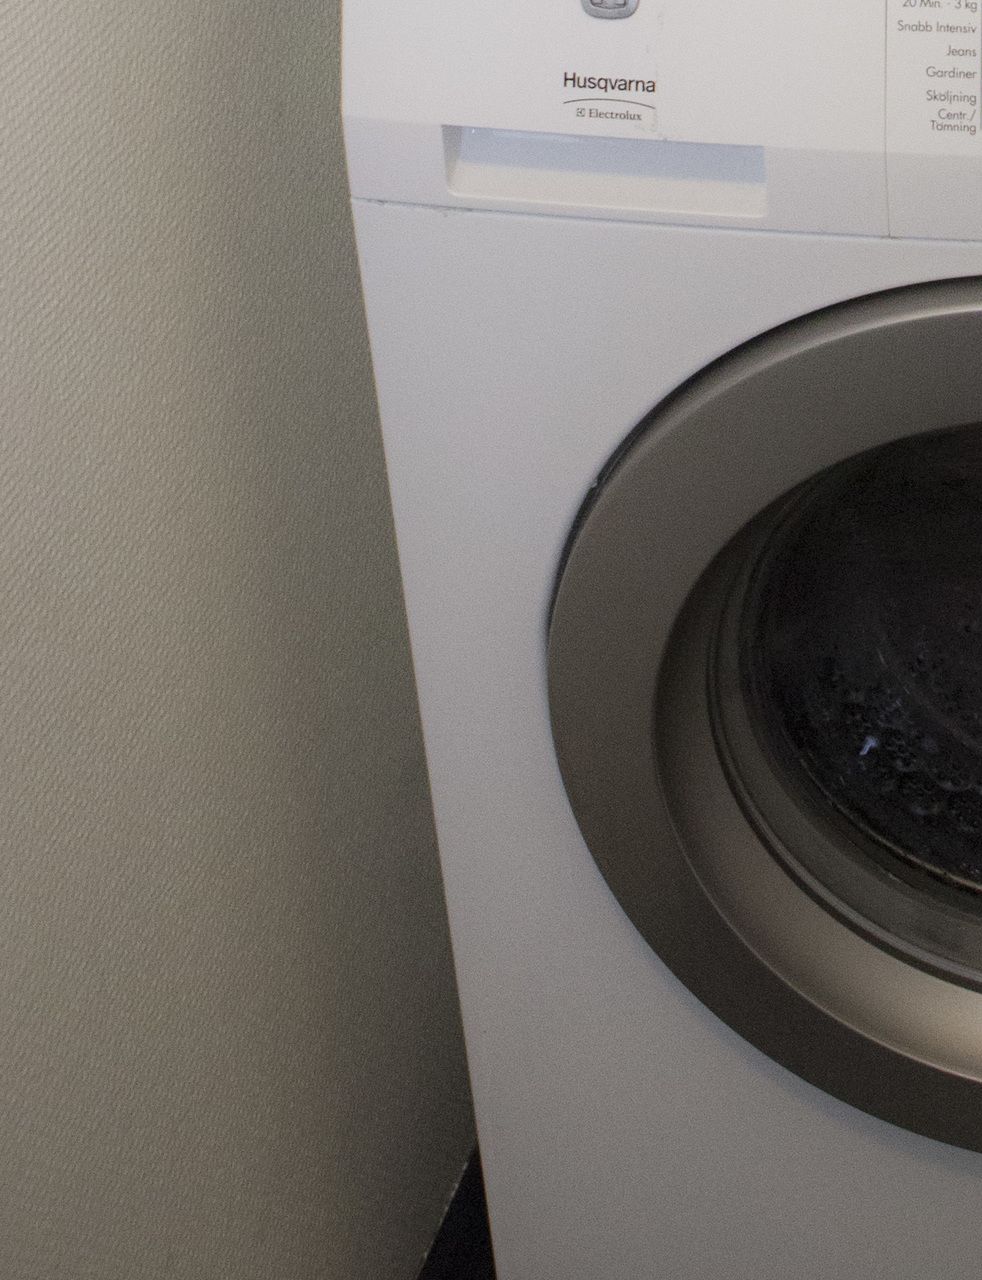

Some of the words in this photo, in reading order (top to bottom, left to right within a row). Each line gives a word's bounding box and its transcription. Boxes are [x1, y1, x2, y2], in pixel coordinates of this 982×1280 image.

[898, 20, 932, 32] Snabb
[937, 21, 977, 34] Intensiv
[946, 46, 977, 57] Jeans
[926, 67, 977, 79] Gardiner
[563, 72, 656, 93] Husqvarna
[926, 90, 977, 106] Sköljning
[589, 108, 642, 121] Electrolux
[930, 120, 976, 135] Tömning
